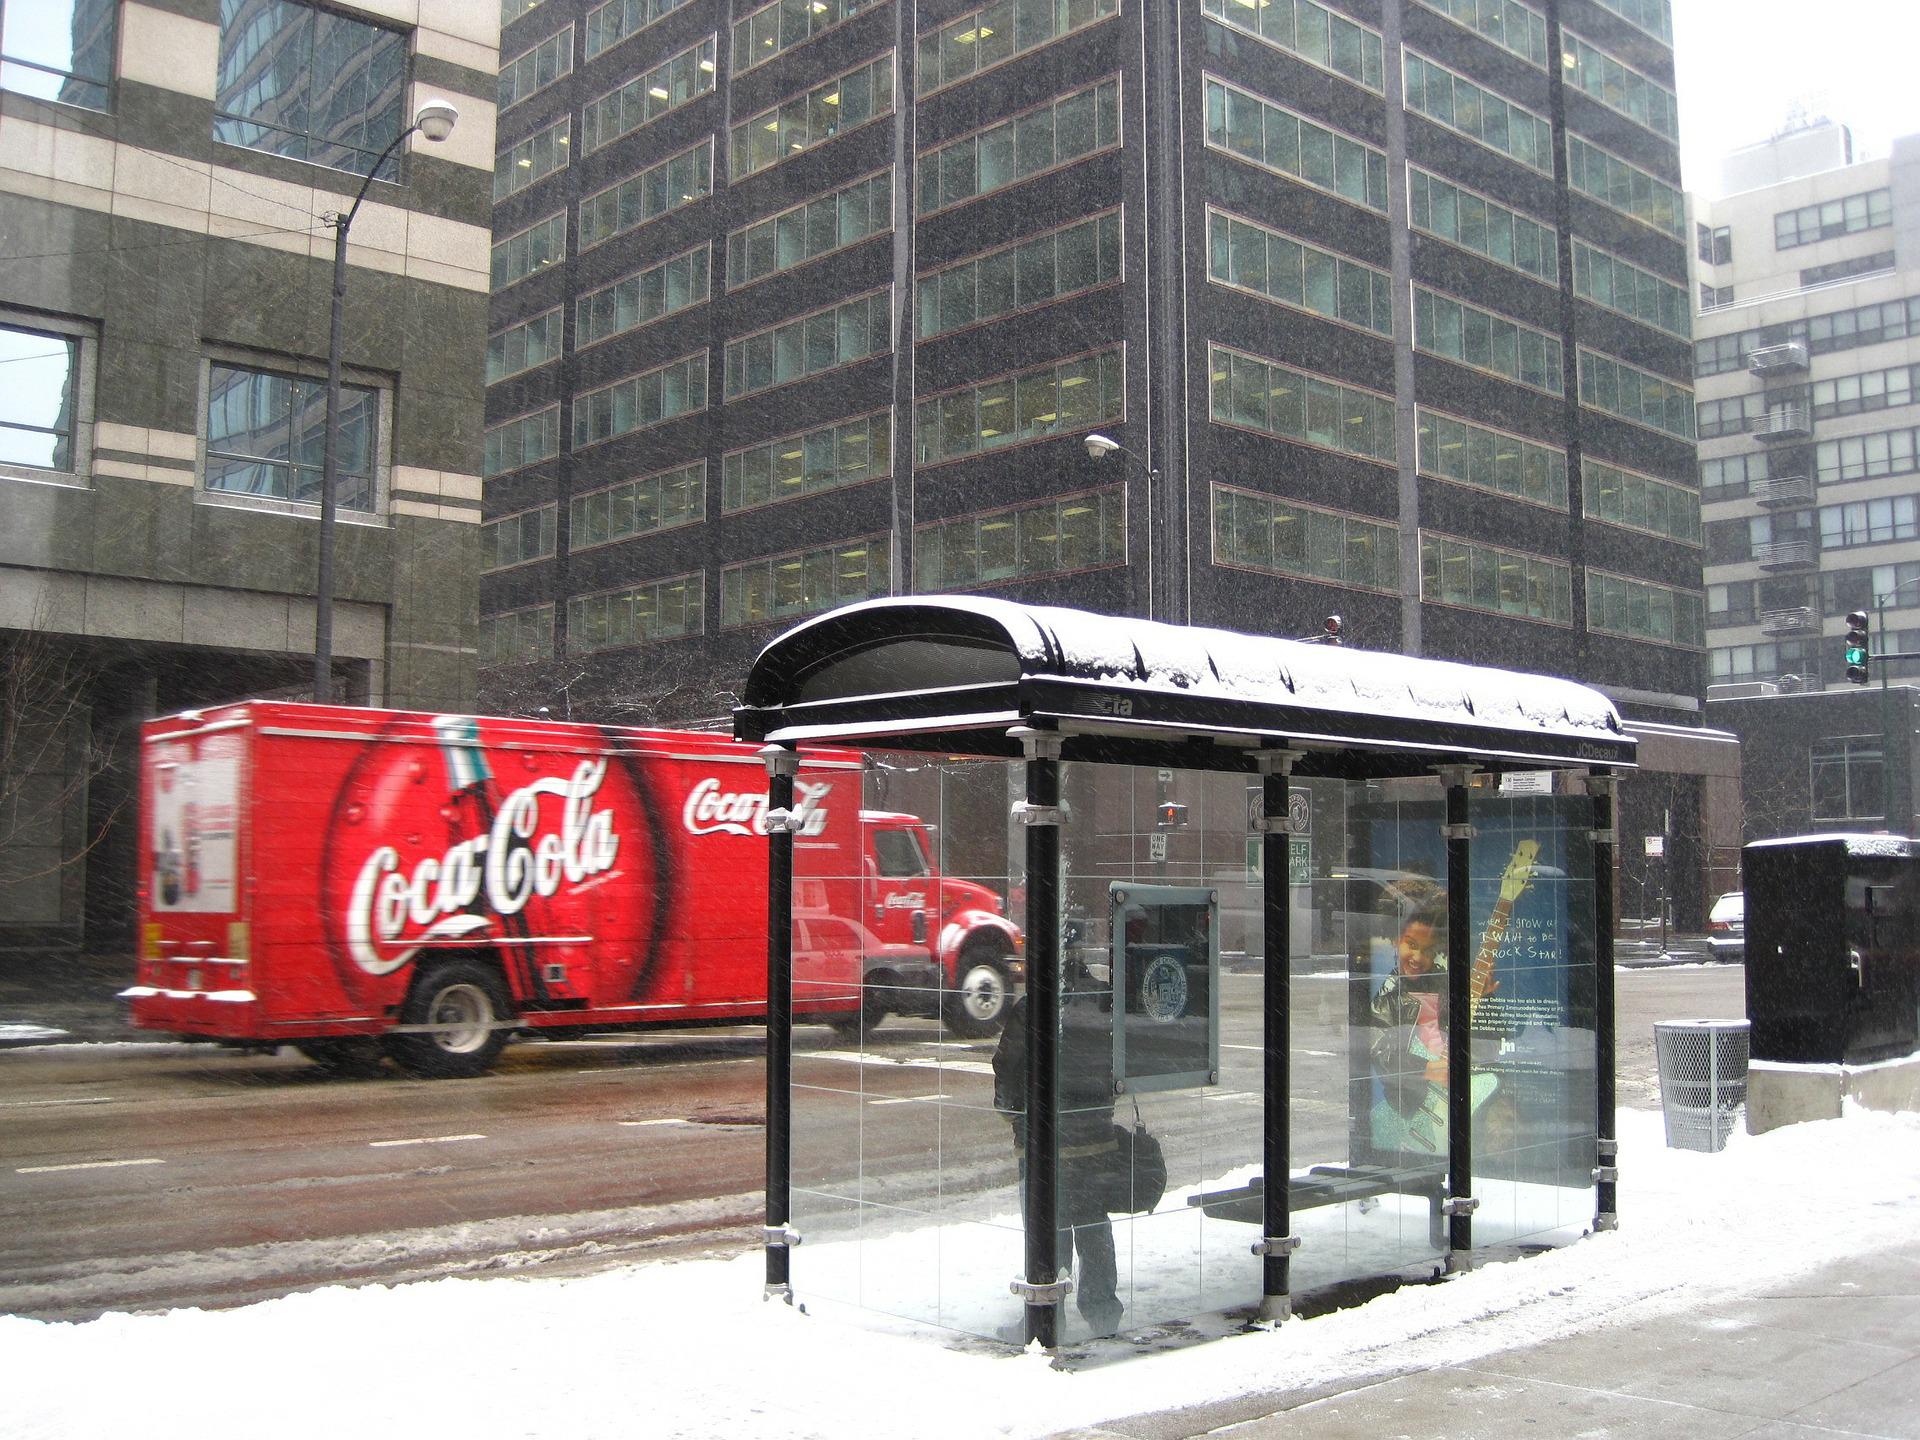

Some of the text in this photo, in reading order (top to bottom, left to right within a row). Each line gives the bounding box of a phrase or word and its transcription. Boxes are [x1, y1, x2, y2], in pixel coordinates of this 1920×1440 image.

[1576, 742, 1618, 760] JCDecaux
[1151, 834, 1165, 842] ONE
[1151, 842, 1165, 850] WAY
[1290, 844, 1307, 855] ELF
[1289, 856, 1308, 867] ARK
[1504, 917, 1511, 926] I
[1527, 934, 1537, 942] to
[1492, 946, 1522, 958] ROCK
